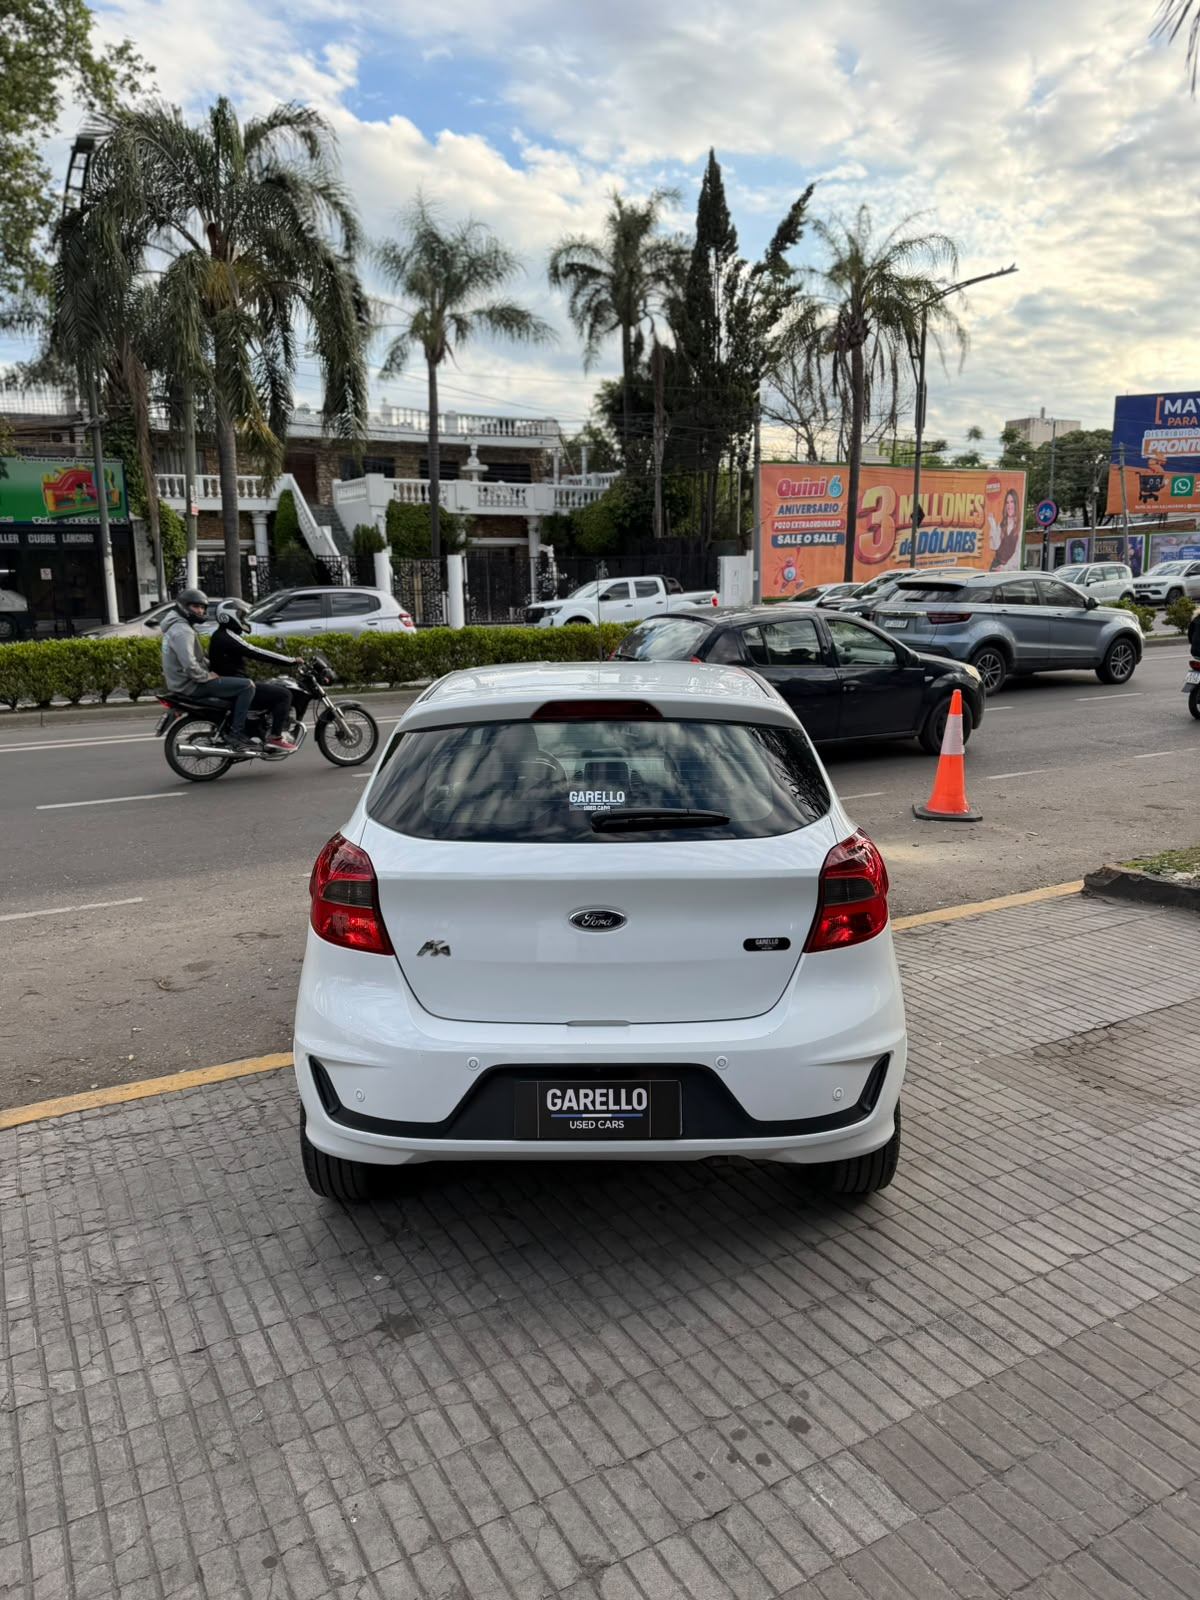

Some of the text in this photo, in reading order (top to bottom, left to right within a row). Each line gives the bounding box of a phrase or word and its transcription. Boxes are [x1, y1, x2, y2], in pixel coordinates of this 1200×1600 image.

[1167, 416, 1198, 427] PARA
[777, 475, 843, 498] Quini 6
[778, 503, 839, 515] ANIVERSARIO
[774, 520, 790, 529] POZO
[858, 485, 897, 559] 3
[27, 533, 56, 543] CUBRE
[777, 532, 838, 545] SALE O SALE
[917, 527, 977, 555] DÓLARES
[569, 791, 625, 803] GARELLO
[581, 913, 613, 927] Ford
[546, 1088, 648, 1111] GARELLO
[569, 1120, 625, 1129] USED CARS
